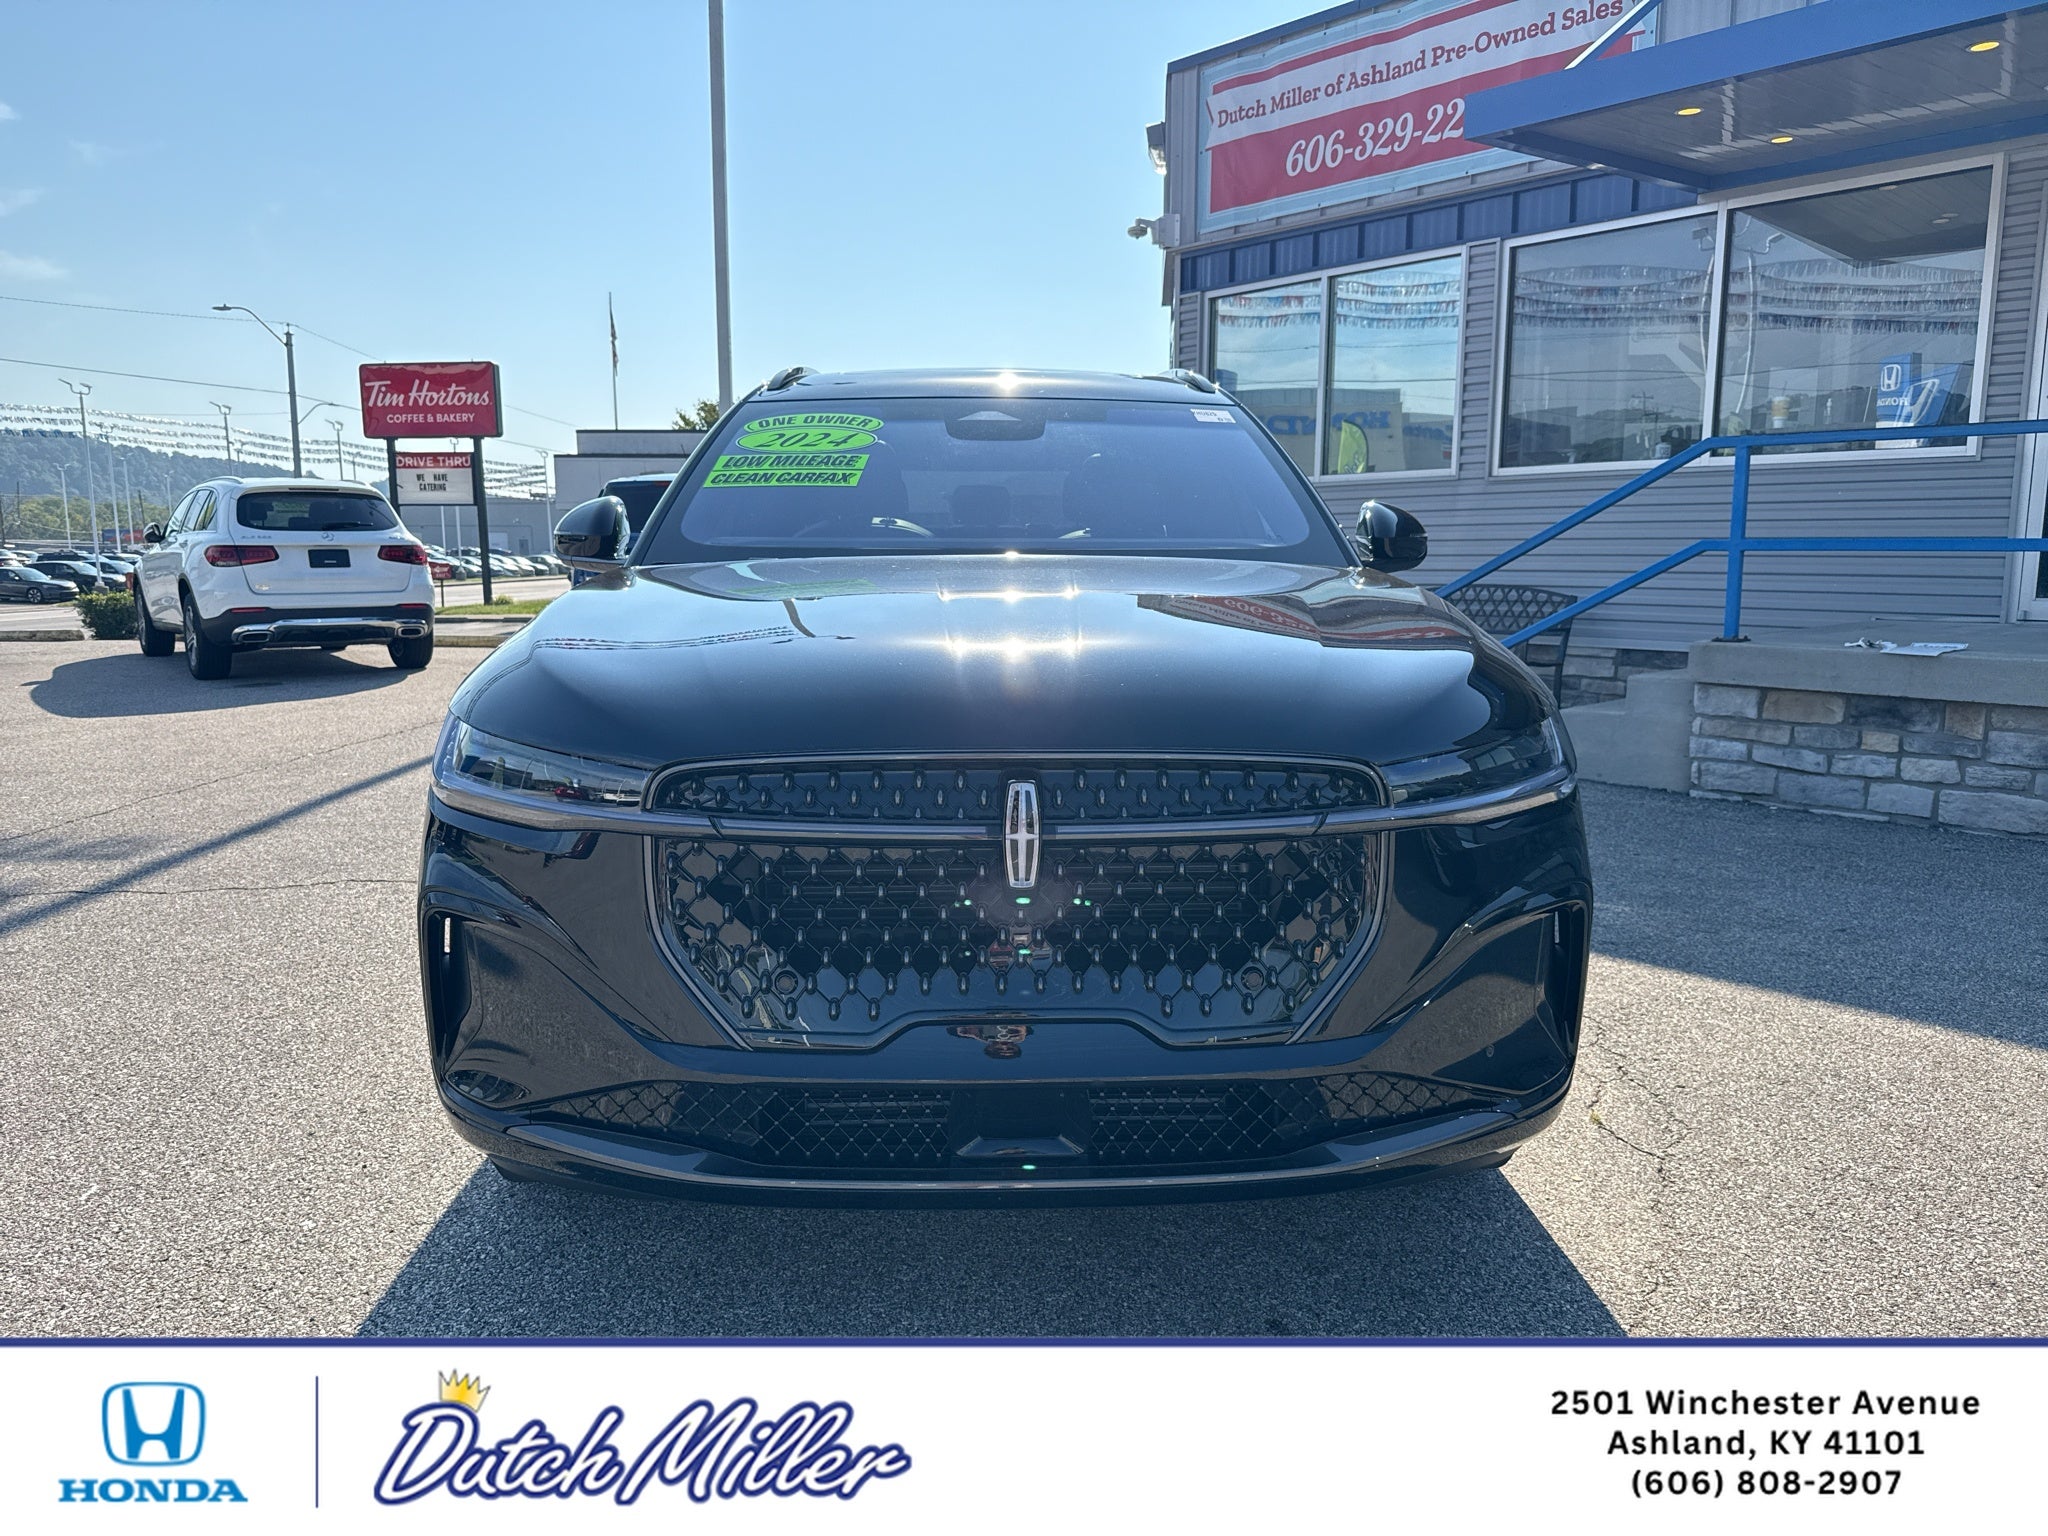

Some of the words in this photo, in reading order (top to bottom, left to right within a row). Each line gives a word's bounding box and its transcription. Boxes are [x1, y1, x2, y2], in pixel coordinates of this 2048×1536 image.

[1217, 99, 1267, 128] Dutch
[1270, 85, 1321, 114] Miller
[1324, 74, 1346, 98] of
[1346, 48, 1427, 92] Ashland
[1430, 11, 1556, 68] Pre-Owned
[1561, 0, 1623, 31] Sales
[364, 380, 404, 407] Tim
[408, 379, 490, 407] Hortons
[386, 413, 425, 424] COFFEE
[427, 413, 434, 423] &
[436, 412, 475, 423] BAKERY
[758, 415, 797, 429] ONE
[802, 415, 873, 428] OWNER
[753, 432, 859, 448] 2024
[396, 456, 434, 467] DRIVE
[438, 455, 471, 467] THRU
[722, 455, 770, 469] LOW
[768, 454, 862, 469] MILEAGE
[416, 473, 425, 482] WE
[433, 473, 449, 482] HAVE
[710, 472, 776, 485] CLEAN
[775, 471, 857, 485] CARFAX
[419, 482, 447, 492] CATERING
